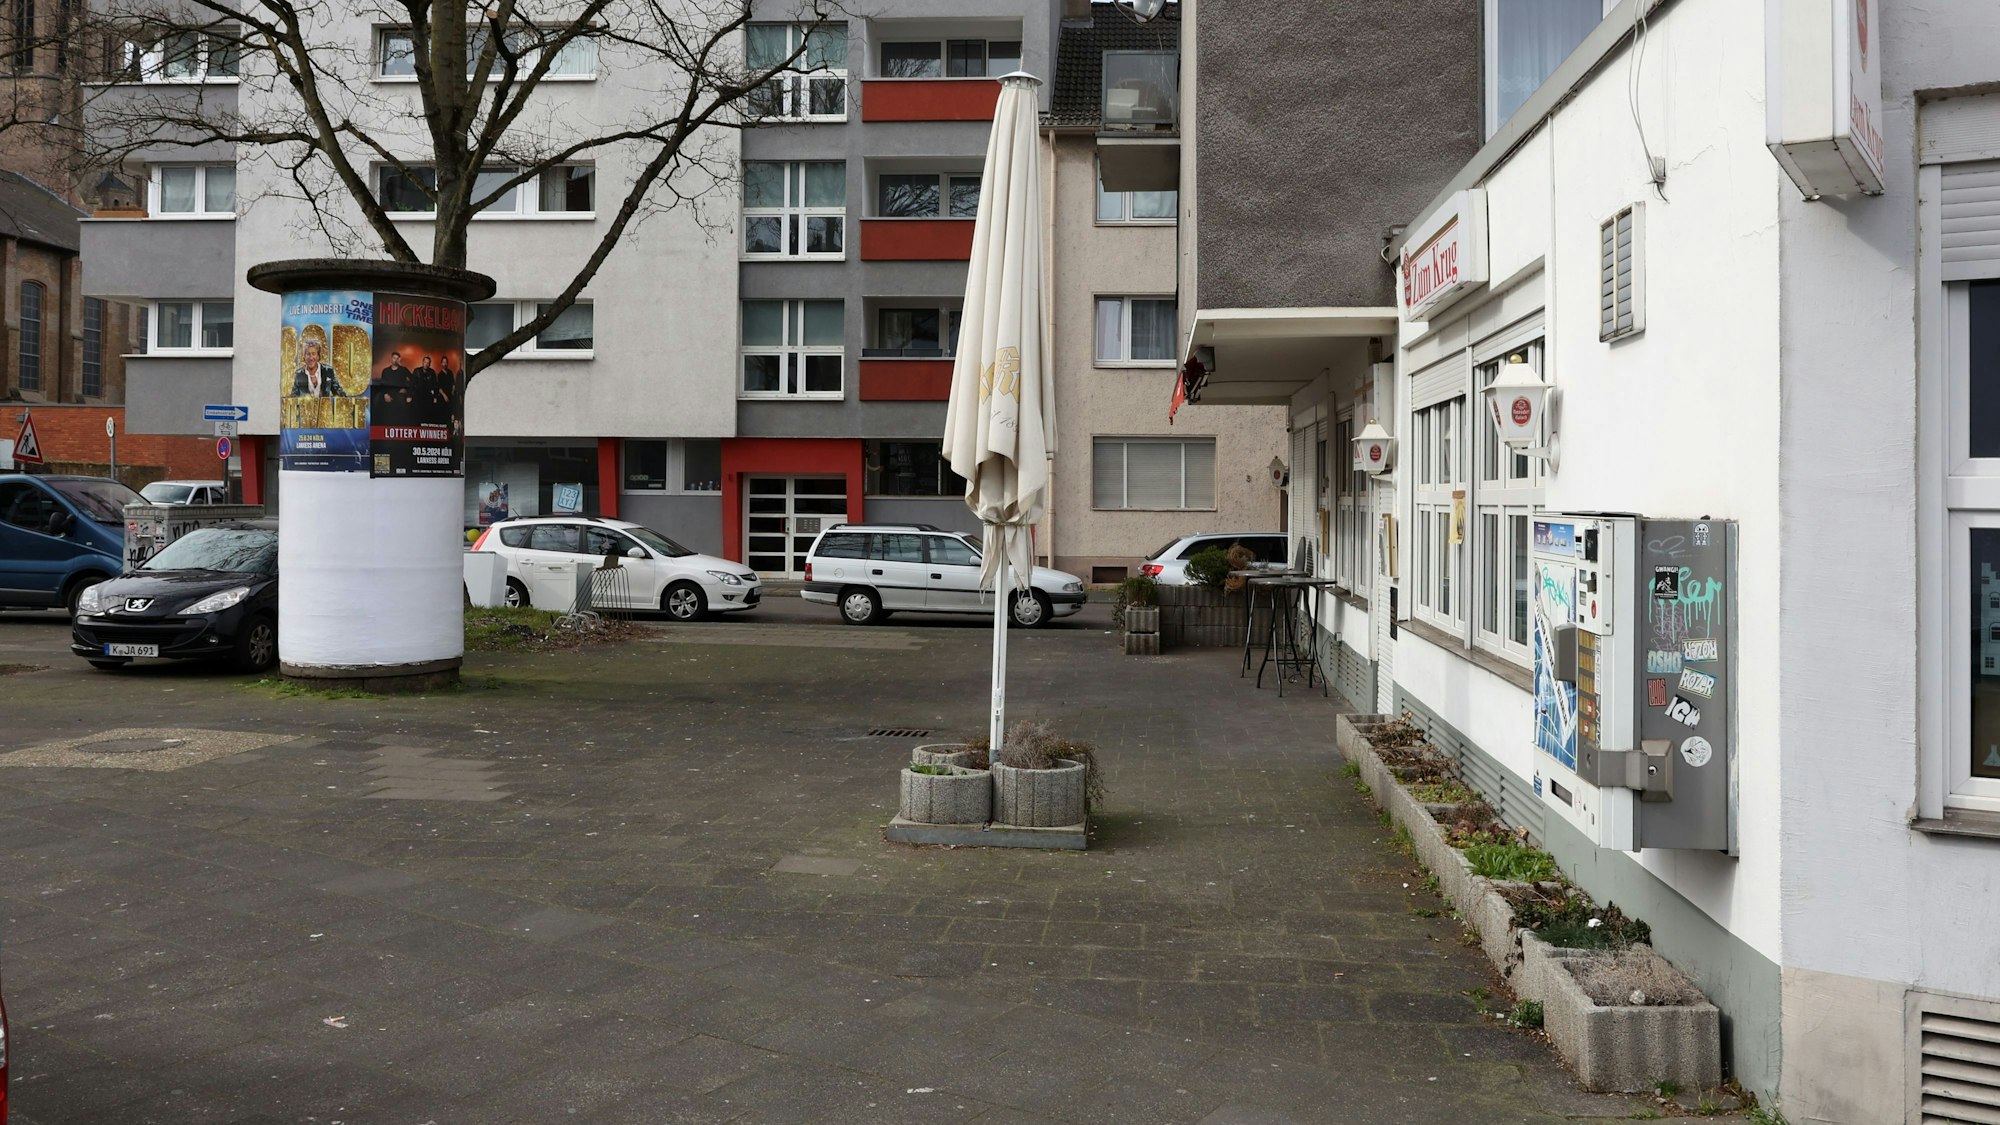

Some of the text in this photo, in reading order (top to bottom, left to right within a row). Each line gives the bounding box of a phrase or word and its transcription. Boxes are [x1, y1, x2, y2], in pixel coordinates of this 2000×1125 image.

[1412, 263, 1431, 305] Zum
[1432, 242, 1457, 284] Krug
[290, 303, 343, 315] LIVE IN CONCERT
[350, 299, 373, 311] ONE
[346, 312, 373, 324] TIME
[385, 428, 448, 440] LOTTERY WINNERS
[412, 446, 453, 457] 30.5.2024 KÖLN
[416, 457, 437, 465] LANXESS
[563, 488, 577, 498] 123
[559, 499, 574, 508] XYZ
[112, 645, 154, 656] K JA 691
[1647, 650, 1682, 673] OSHO
